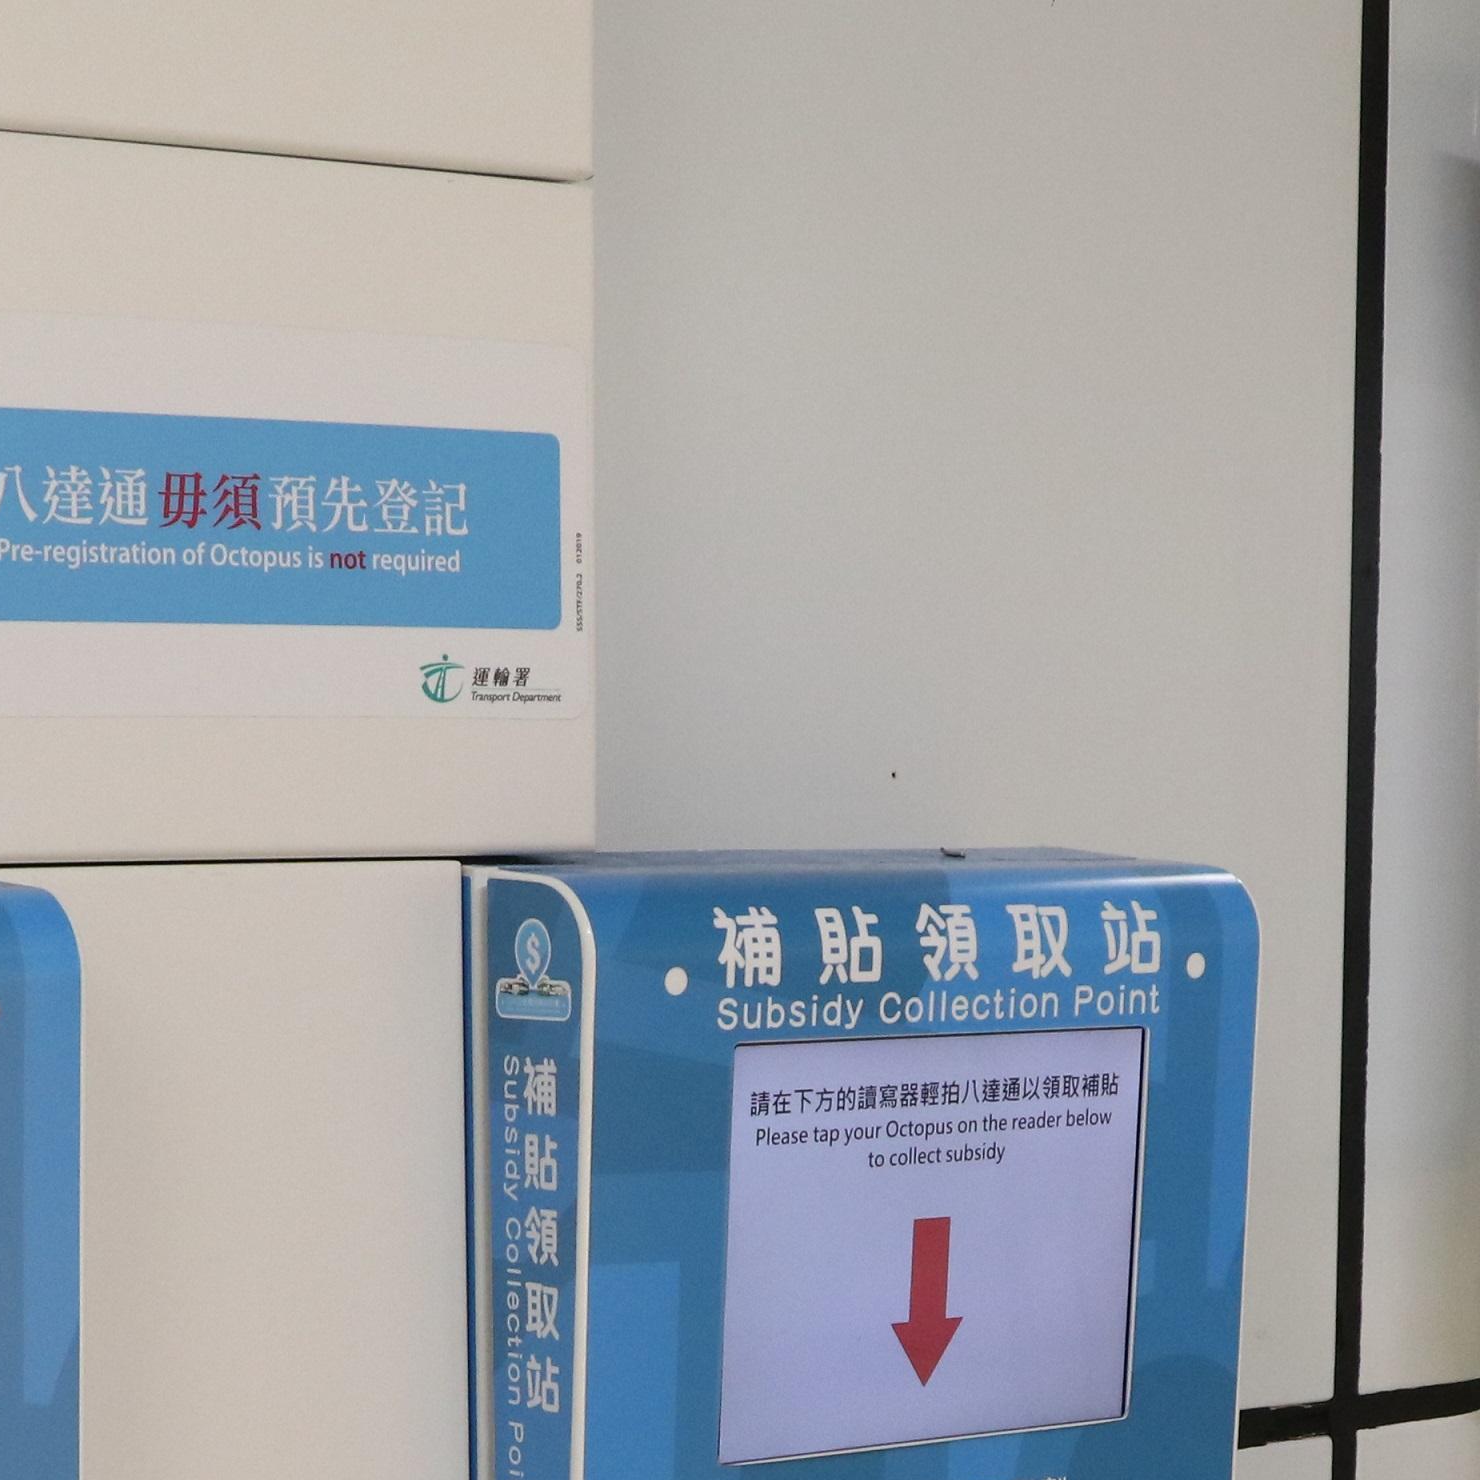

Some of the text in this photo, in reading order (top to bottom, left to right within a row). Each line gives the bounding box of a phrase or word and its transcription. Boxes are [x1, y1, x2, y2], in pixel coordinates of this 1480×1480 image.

[183, 541, 205, 565] of
[211, 543, 302, 573] Octopus
[308, 545, 323, 569] is
[330, 550, 366, 570] not
[373, 548, 460, 577] required
[471, 666, 531, 688] 運輸署
[471, 690, 562, 704] Transport Department
[714, 902, 1161, 989] 補貼領取站
[717, 984, 1159, 1030] Subsidy Collection Point
[751, 1073, 1119, 1117] 請在下方的讀寫器輕拍八達通以領取補貼
[504, 1055, 520, 1202] Subsidy
[756, 1108, 1112, 1147] Please tap your Octopus on the reader below
[869, 1141, 1005, 1168] to collect subsidy
[523, 1056, 560, 1414] 補貼領取站
[506, 1217, 523, 1406] Collection
